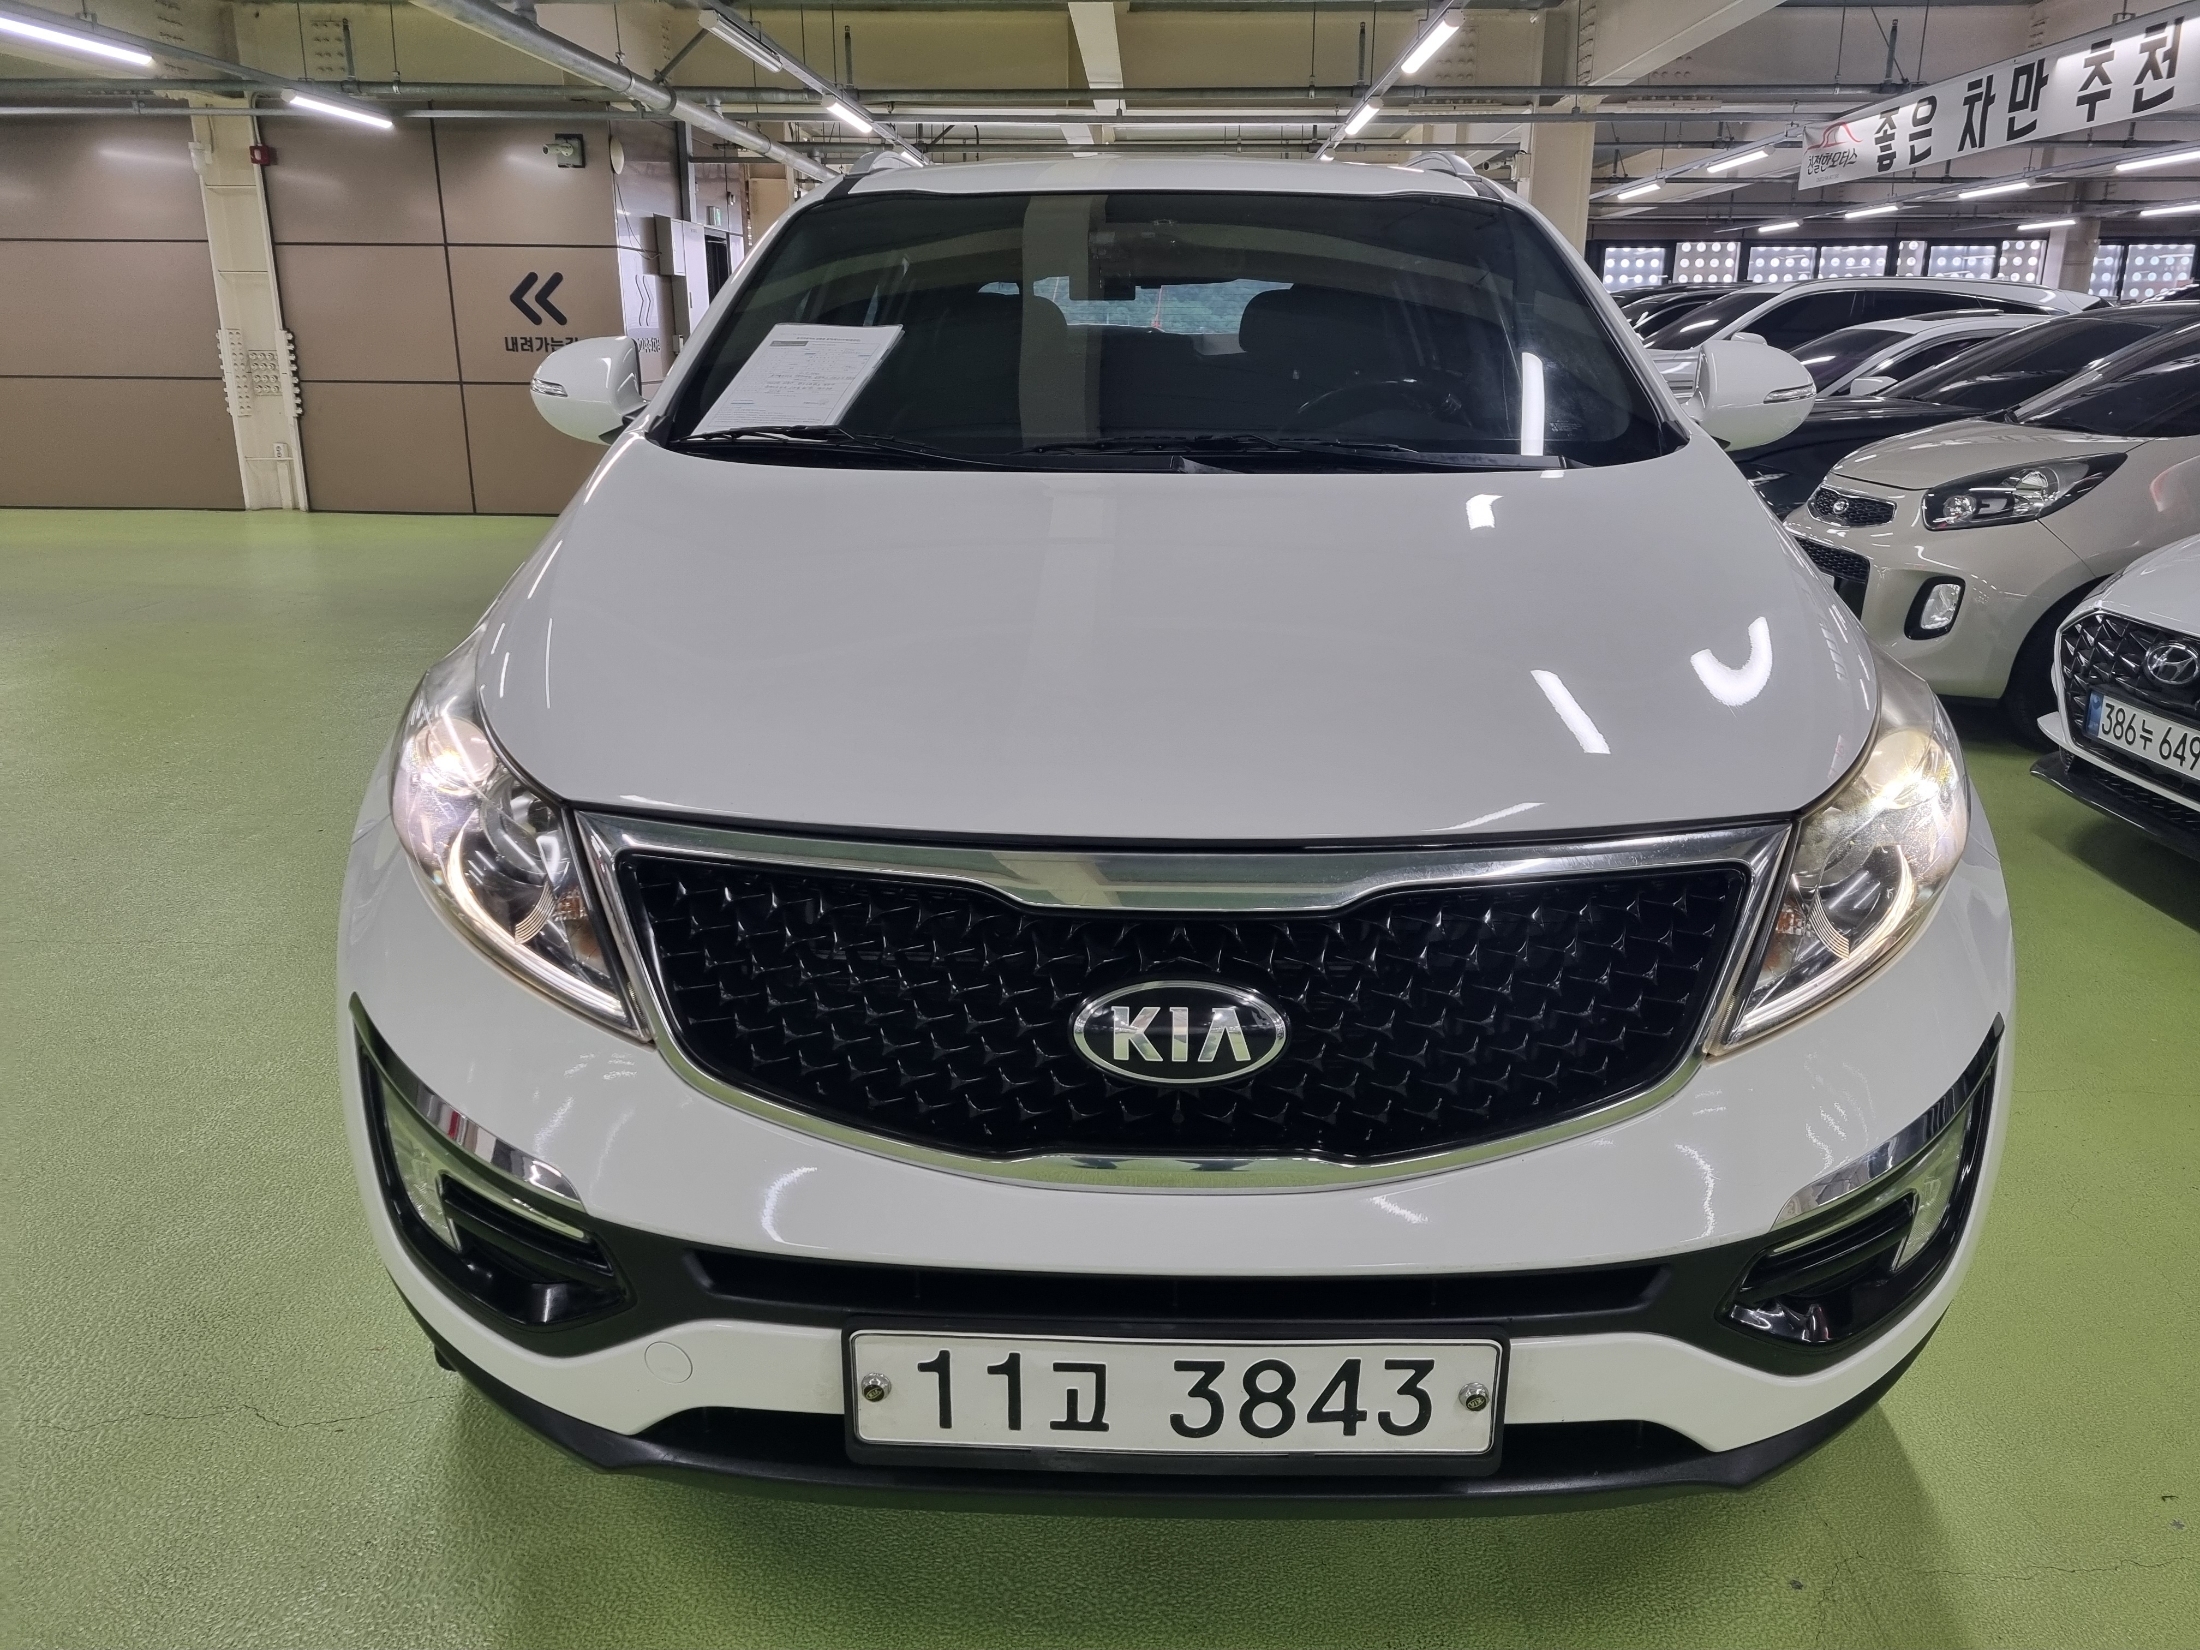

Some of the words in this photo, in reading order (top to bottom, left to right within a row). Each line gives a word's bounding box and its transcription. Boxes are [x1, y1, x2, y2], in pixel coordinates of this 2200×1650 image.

[1874, 95, 1937, 173] 좋은
[1957, 58, 2049, 152] 차만
[2076, 16, 2184, 122] 추천
[2101, 702, 2154, 751] 386누
[1111, 1006, 1251, 1062] KIA
[917, 1349, 1110, 1432] 11고
[1169, 1358, 1436, 1439] 3843
